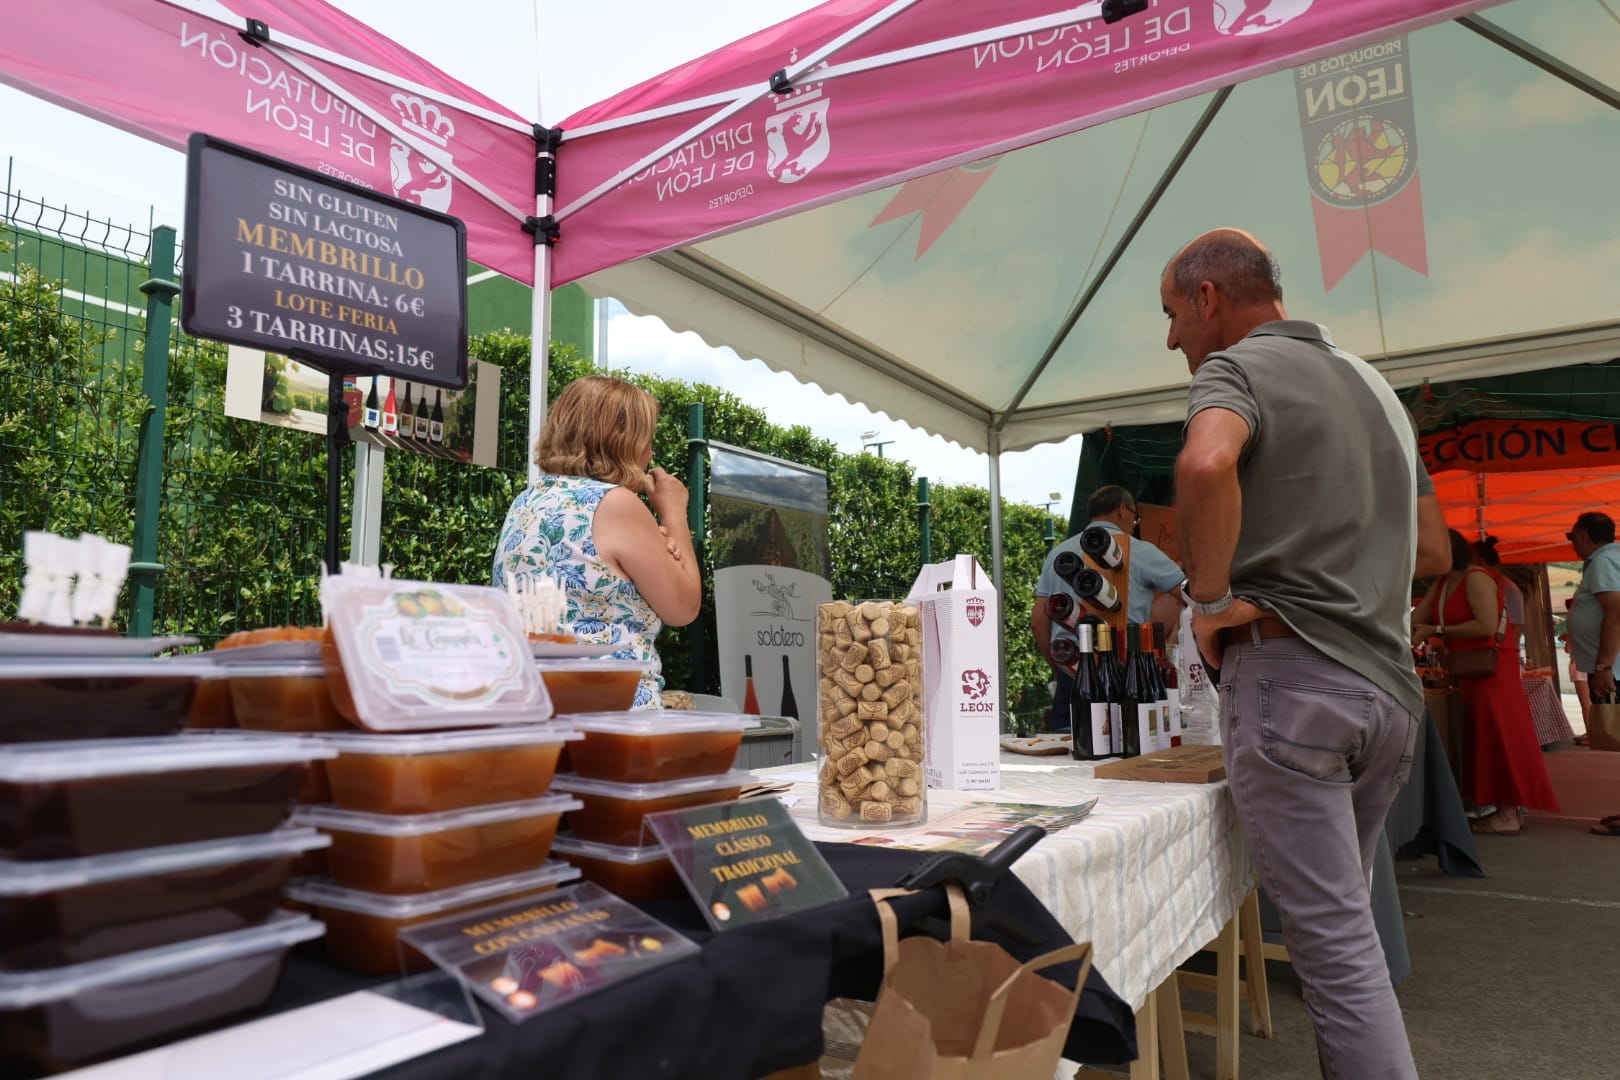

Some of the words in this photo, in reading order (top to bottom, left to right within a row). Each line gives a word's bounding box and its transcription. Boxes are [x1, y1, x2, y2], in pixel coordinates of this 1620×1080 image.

[274, 178, 313, 204] SIN
[317, 192, 399, 233] GLUTEN
[269, 202, 308, 228] SIN
[313, 214, 405, 258] LACTOSA
[235, 217, 426, 290] MEMBRILLO
[241, 251, 253, 274] 1
[260, 256, 389, 309] TARRINA:
[394, 293, 426, 318] 6€
[226, 305, 244, 329] 3
[274, 289, 334, 319] LOTE
[337, 304, 399, 335] FERIA
[1418, 424, 1567, 467] ECCIÓN
[959, 701, 994, 713] LEÓN
[687, 814, 769, 840] MEMBRILLO
[715, 834, 772, 857] CLÁSICO
[710, 851, 802, 883] TRADICIONAL
